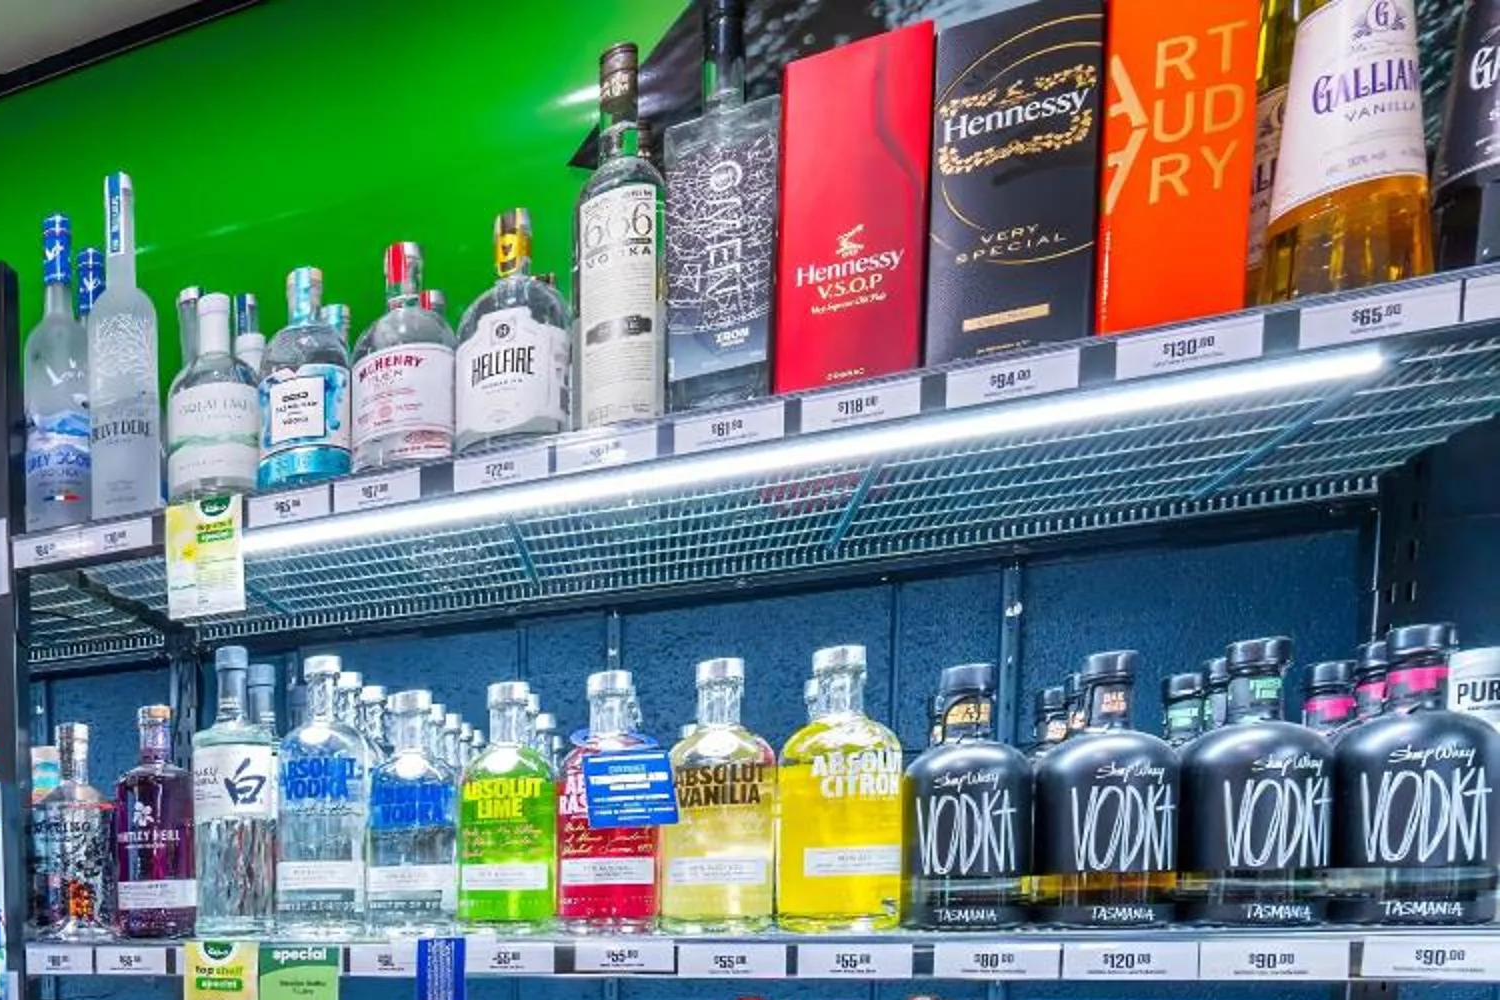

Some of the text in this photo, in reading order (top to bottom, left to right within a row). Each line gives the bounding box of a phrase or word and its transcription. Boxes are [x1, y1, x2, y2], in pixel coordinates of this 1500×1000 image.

[942, 87, 1090, 143] Hennessy
[980, 222, 1040, 245] VERY
[955, 231, 1069, 265] SPECIAL
[795, 247, 905, 288] Hennessy
[471, 345, 535, 389] HELLFIRE
[224, 756, 268, 806] 白
[463, 777, 542, 799] ABSOLUT
[675, 763, 765, 788] ABSOLUT
[819, 769, 899, 798] CITRON
[285, 780, 349, 799] VODKA
[381, 803, 445, 824] VODKA
[477, 798, 524, 819] LIME
[1360, 767, 1493, 863] VODKA
[915, 789, 1018, 876] VODKA
[1069, 783, 1177, 871] VODKA
[1224, 776, 1332, 868] VODKA
[936, 908, 998, 922] TASMANIA
[1091, 905, 1156, 921] TASMANIA
[1244, 903, 1312, 920] TASMANIA
[1380, 901, 1464, 917] TASMANIA
[272, 946, 327, 964] special
